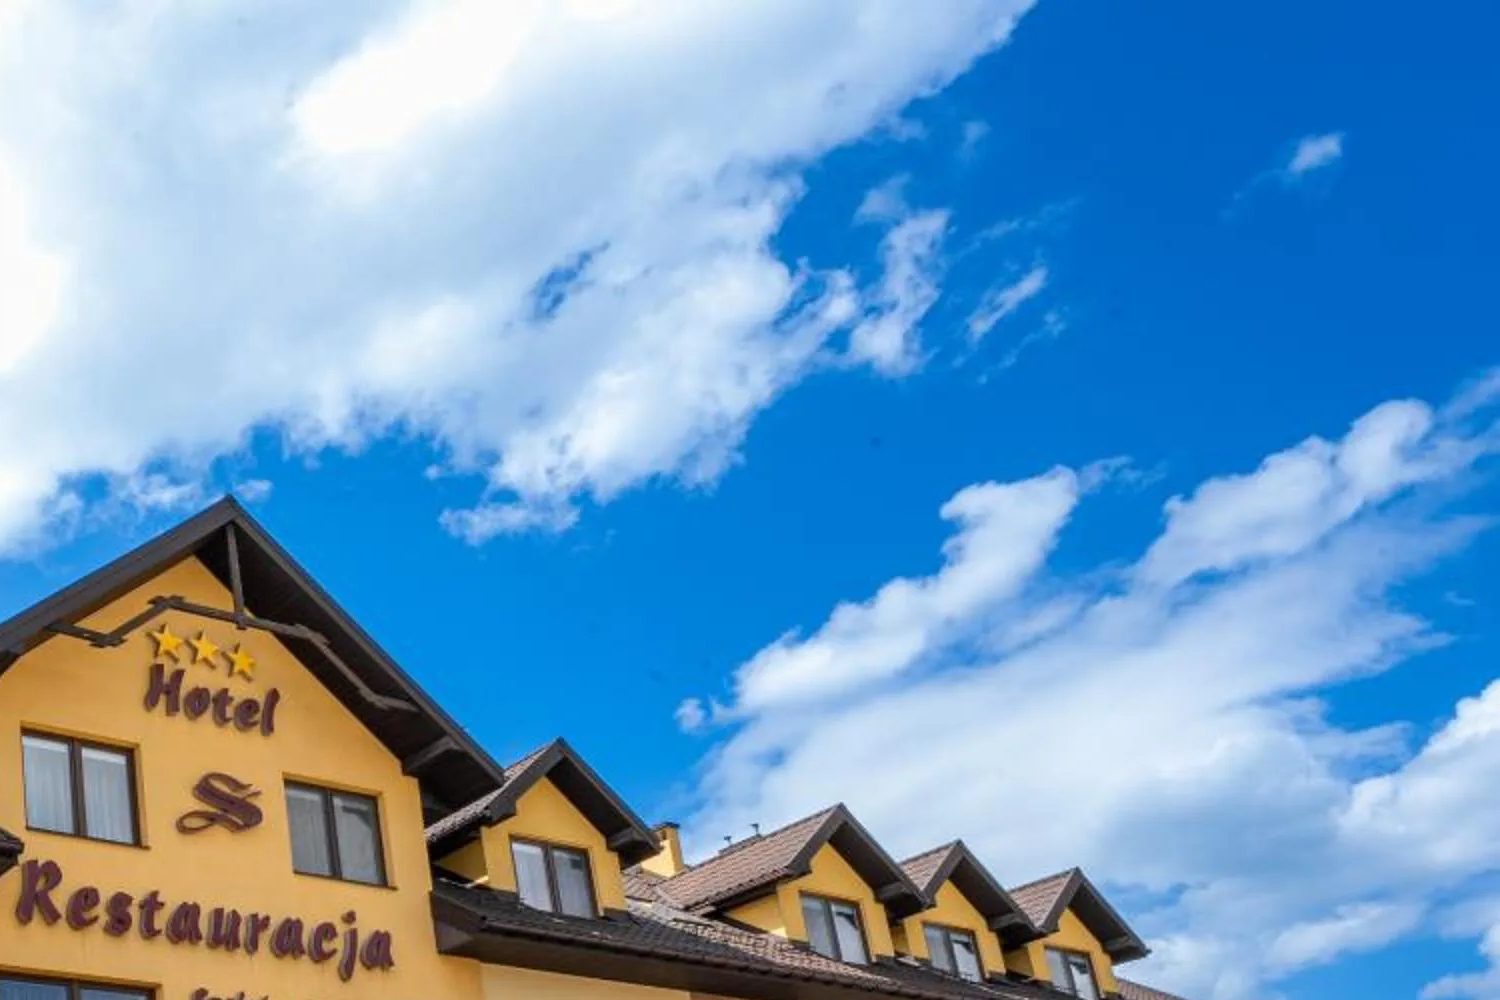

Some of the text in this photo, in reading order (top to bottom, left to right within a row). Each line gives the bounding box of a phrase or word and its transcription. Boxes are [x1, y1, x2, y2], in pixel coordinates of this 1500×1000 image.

[143, 663, 281, 736] Hotel
[176, 772, 263, 834] S
[14, 858, 395, 982] Restauracja
